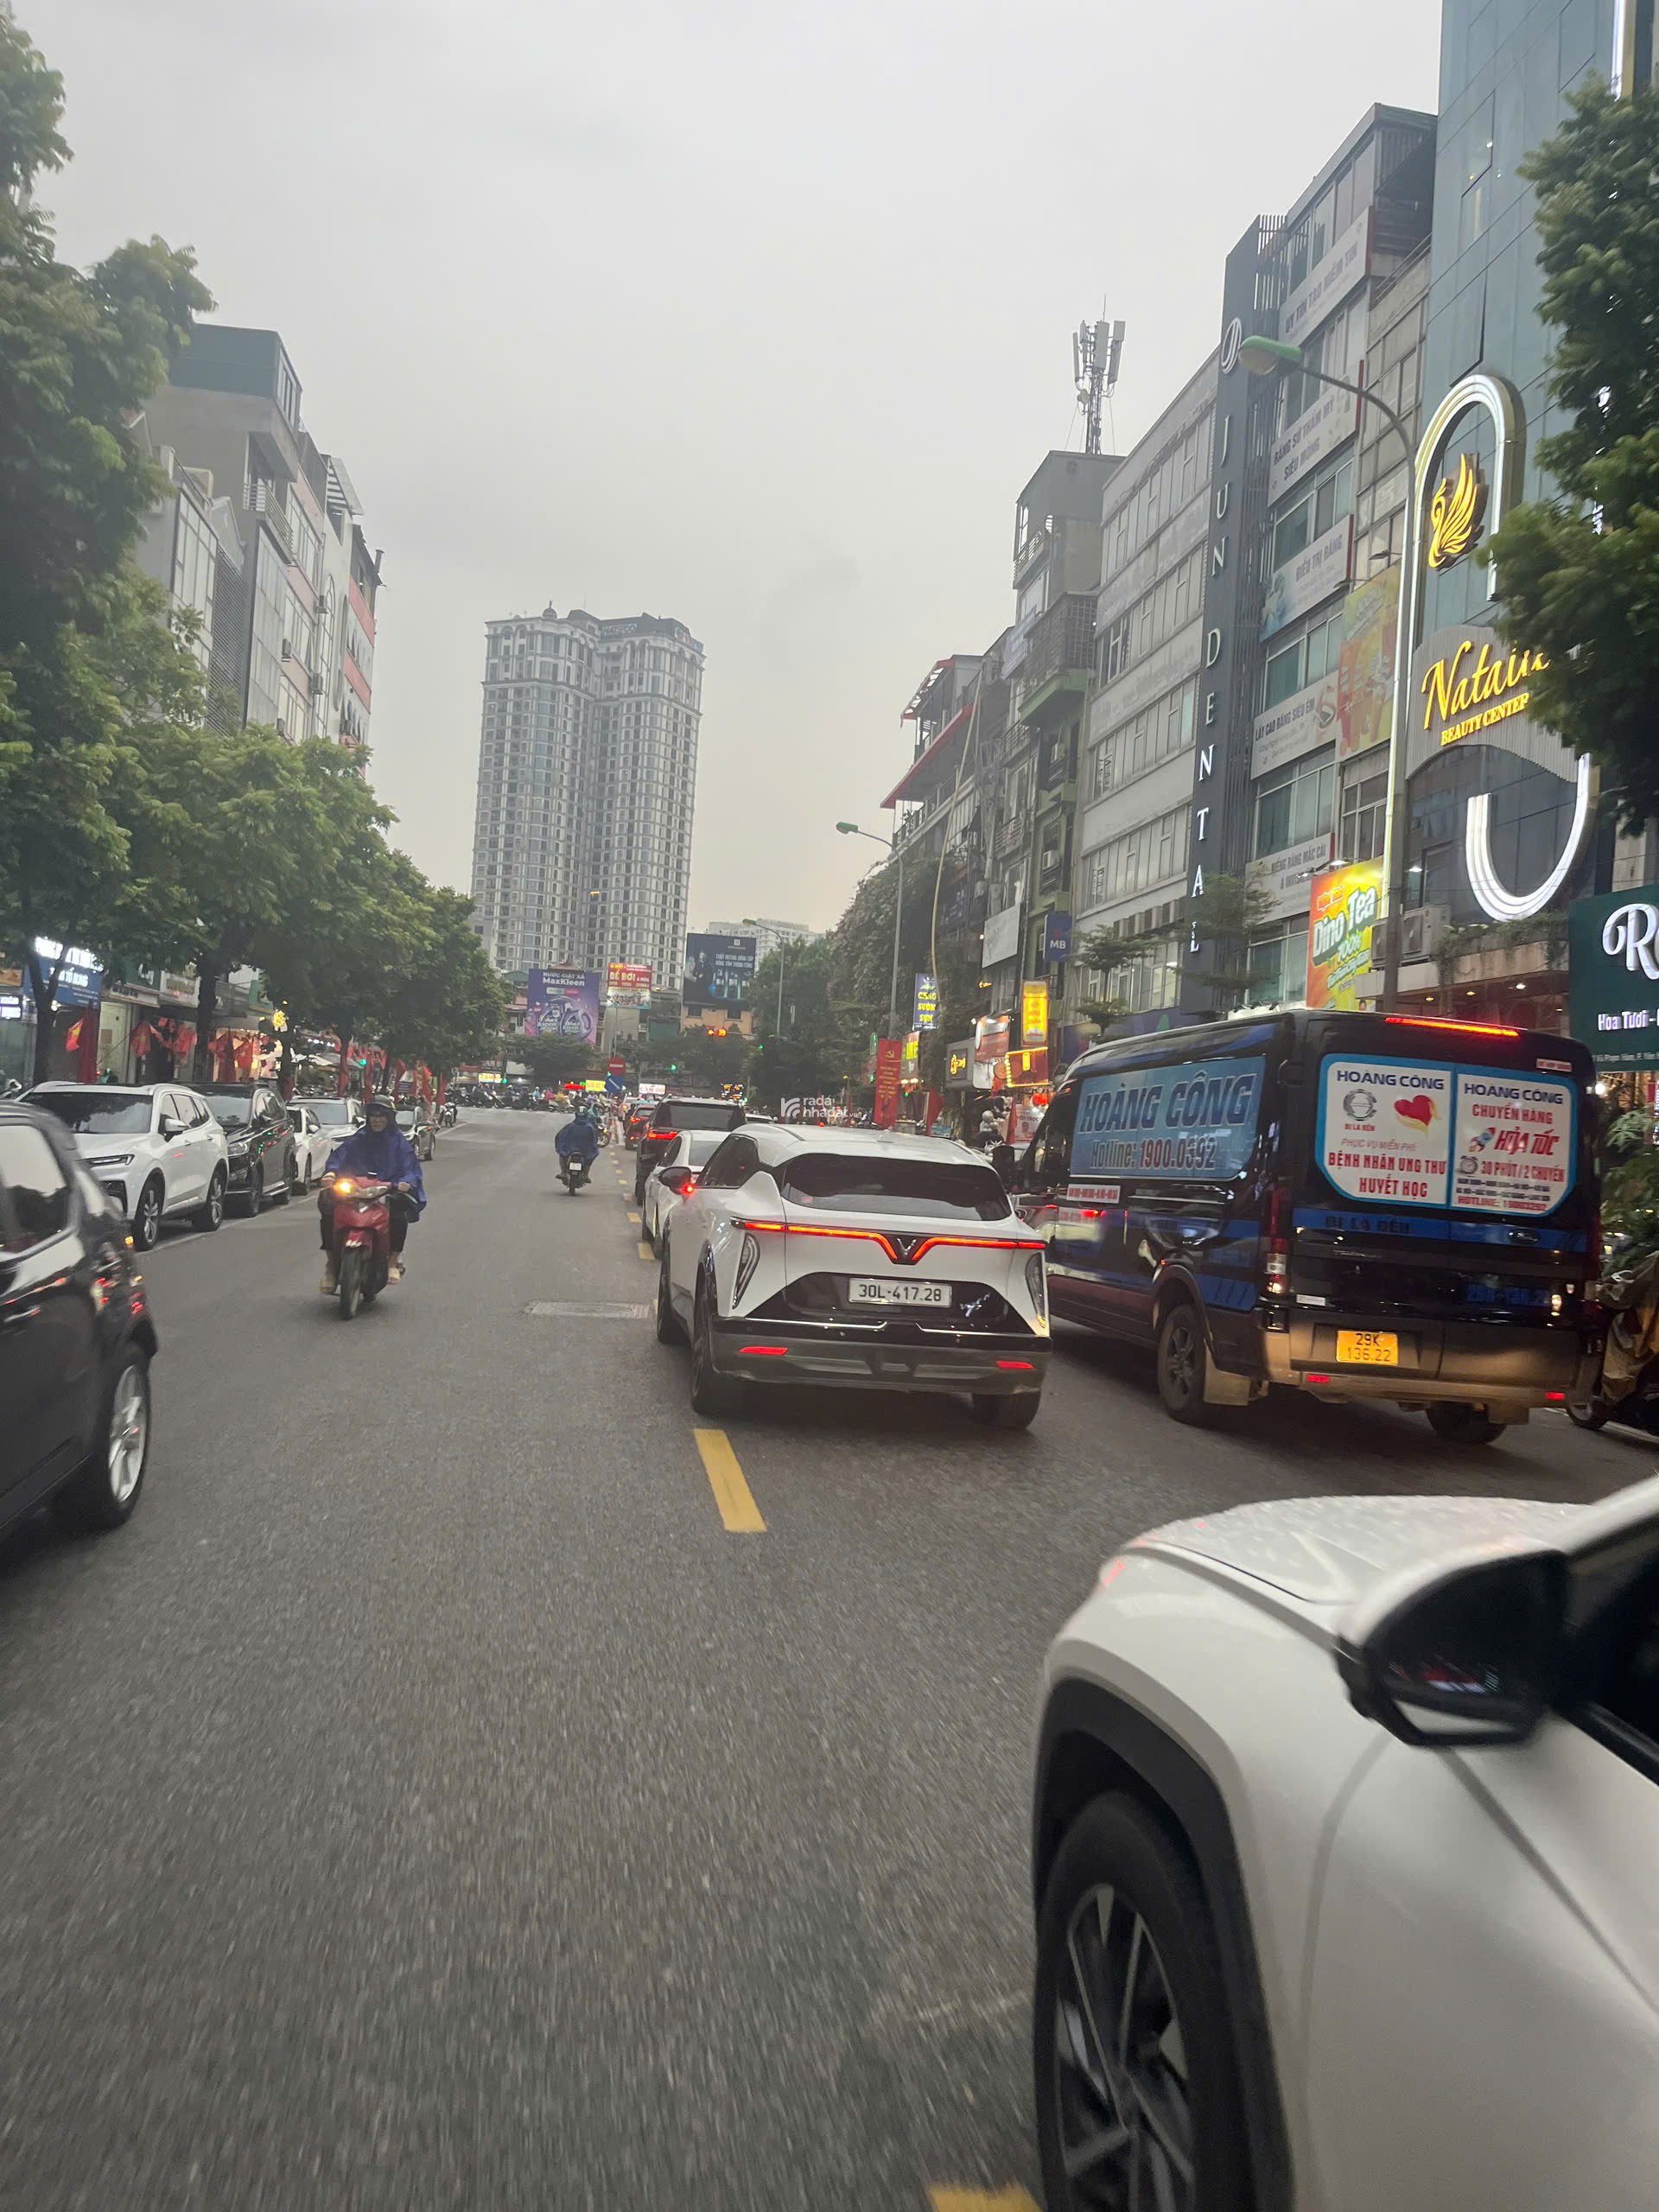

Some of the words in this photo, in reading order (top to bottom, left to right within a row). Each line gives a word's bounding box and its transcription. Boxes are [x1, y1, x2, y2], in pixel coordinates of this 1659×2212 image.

[1265, 720, 1276, 736] CAO
[1276, 712, 1292, 730] RĂNG
[1292, 702, 1306, 721] SIÊU
[1440, 713, 1484, 747] BEAUTY
[1483, 692, 1529, 727] CENTER
[1313, 911, 1345, 959] Dino
[1347, 887, 1376, 932] Tea
[1050, 939, 1066, 950] MB
[1338, 932, 1363, 963] 100%
[1602, 903, 1659, 980] R
[542, 977, 585, 987] MaxKleen
[1599, 1014, 1620, 1032] Hoa
[1622, 1008, 1648, 1030] Tươi
[1336, 1069, 1397, 1086] HOÀNG
[1399, 1074, 1446, 1090] CÔNG
[1078, 1082, 1164, 1135] HOÀNG
[1166, 1069, 1258, 1129] CÔNG
[1464, 1083, 1520, 1100] HOÀNG
[1522, 1088, 1564, 1105] CÔNG
[1522, 1108, 1554, 1125] HÀNG
[1090, 1138, 1137, 1169] Hotline:
[1140, 1136, 1217, 1171] 1900.0392
[1530, 1128, 1560, 1155] TỐC
[1328, 1150, 1361, 1170] BỆNH
[1363, 1154, 1395, 1171] NHÂN
[1398, 1157, 1422, 1173] UNG
[1425, 1160, 1447, 1175] THƯ
[1481, 1160, 1493, 1175] 30
[1494, 1160, 1518, 1178] PHÚT
[1524, 1164, 1530, 1179] 2
[1359, 1173, 1401, 1195] HUYẾT
[1402, 1181, 1429, 1200] HỌC
[858, 1284, 943, 1302] 30L-417.28
[1355, 1332, 1381, 1347] 29K
[1348, 1346, 1392, 1363] 136.22
